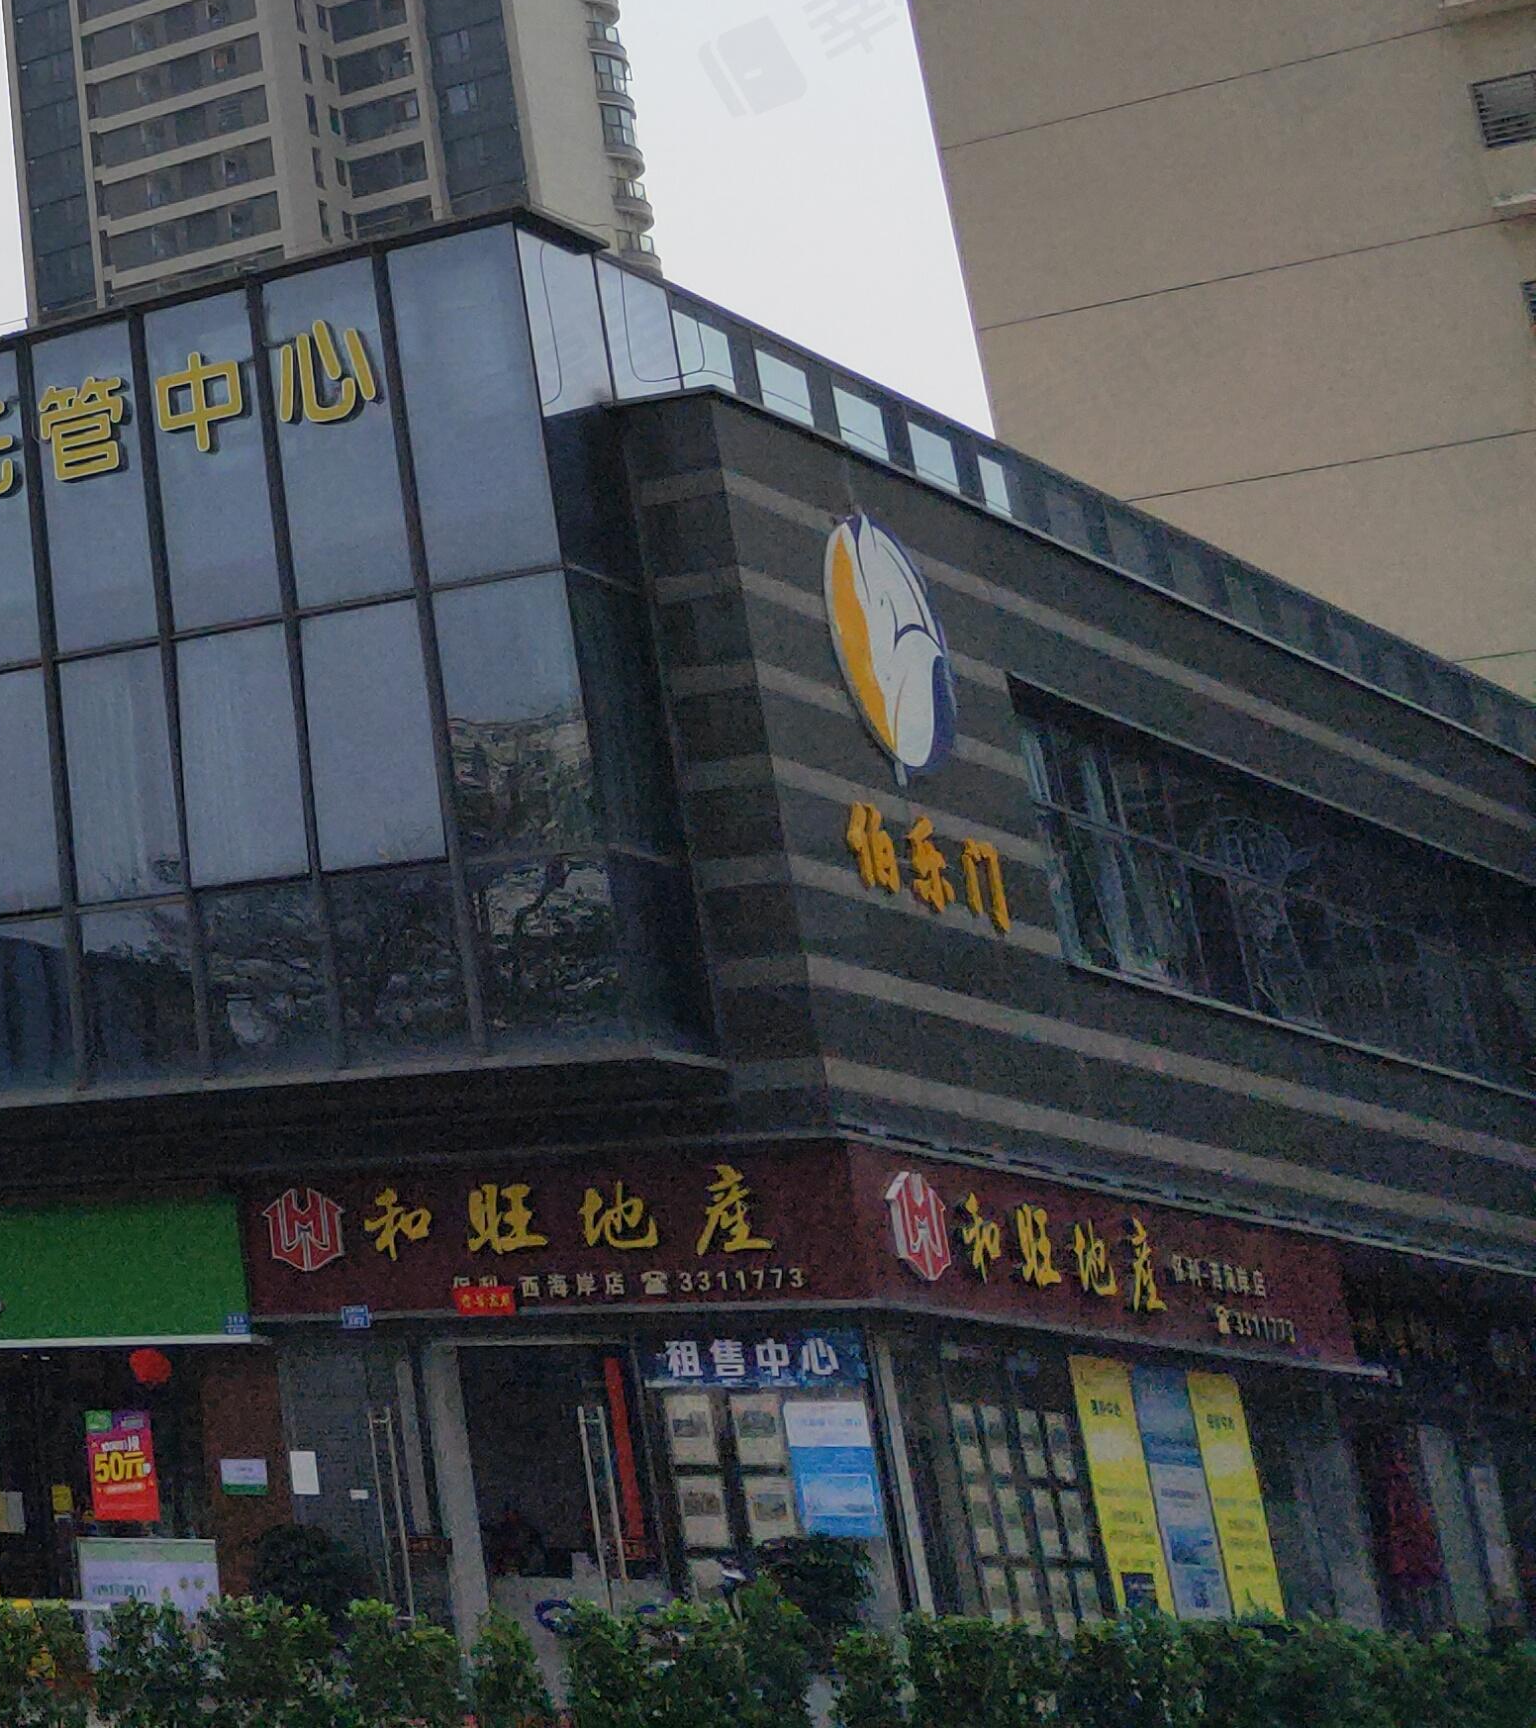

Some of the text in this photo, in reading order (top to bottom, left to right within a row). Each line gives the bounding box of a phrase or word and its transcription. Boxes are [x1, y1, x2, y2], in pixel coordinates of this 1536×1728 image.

[679, 1269, 805, 1292] 3311773
[665, 1336, 839, 1378] 租售中心
